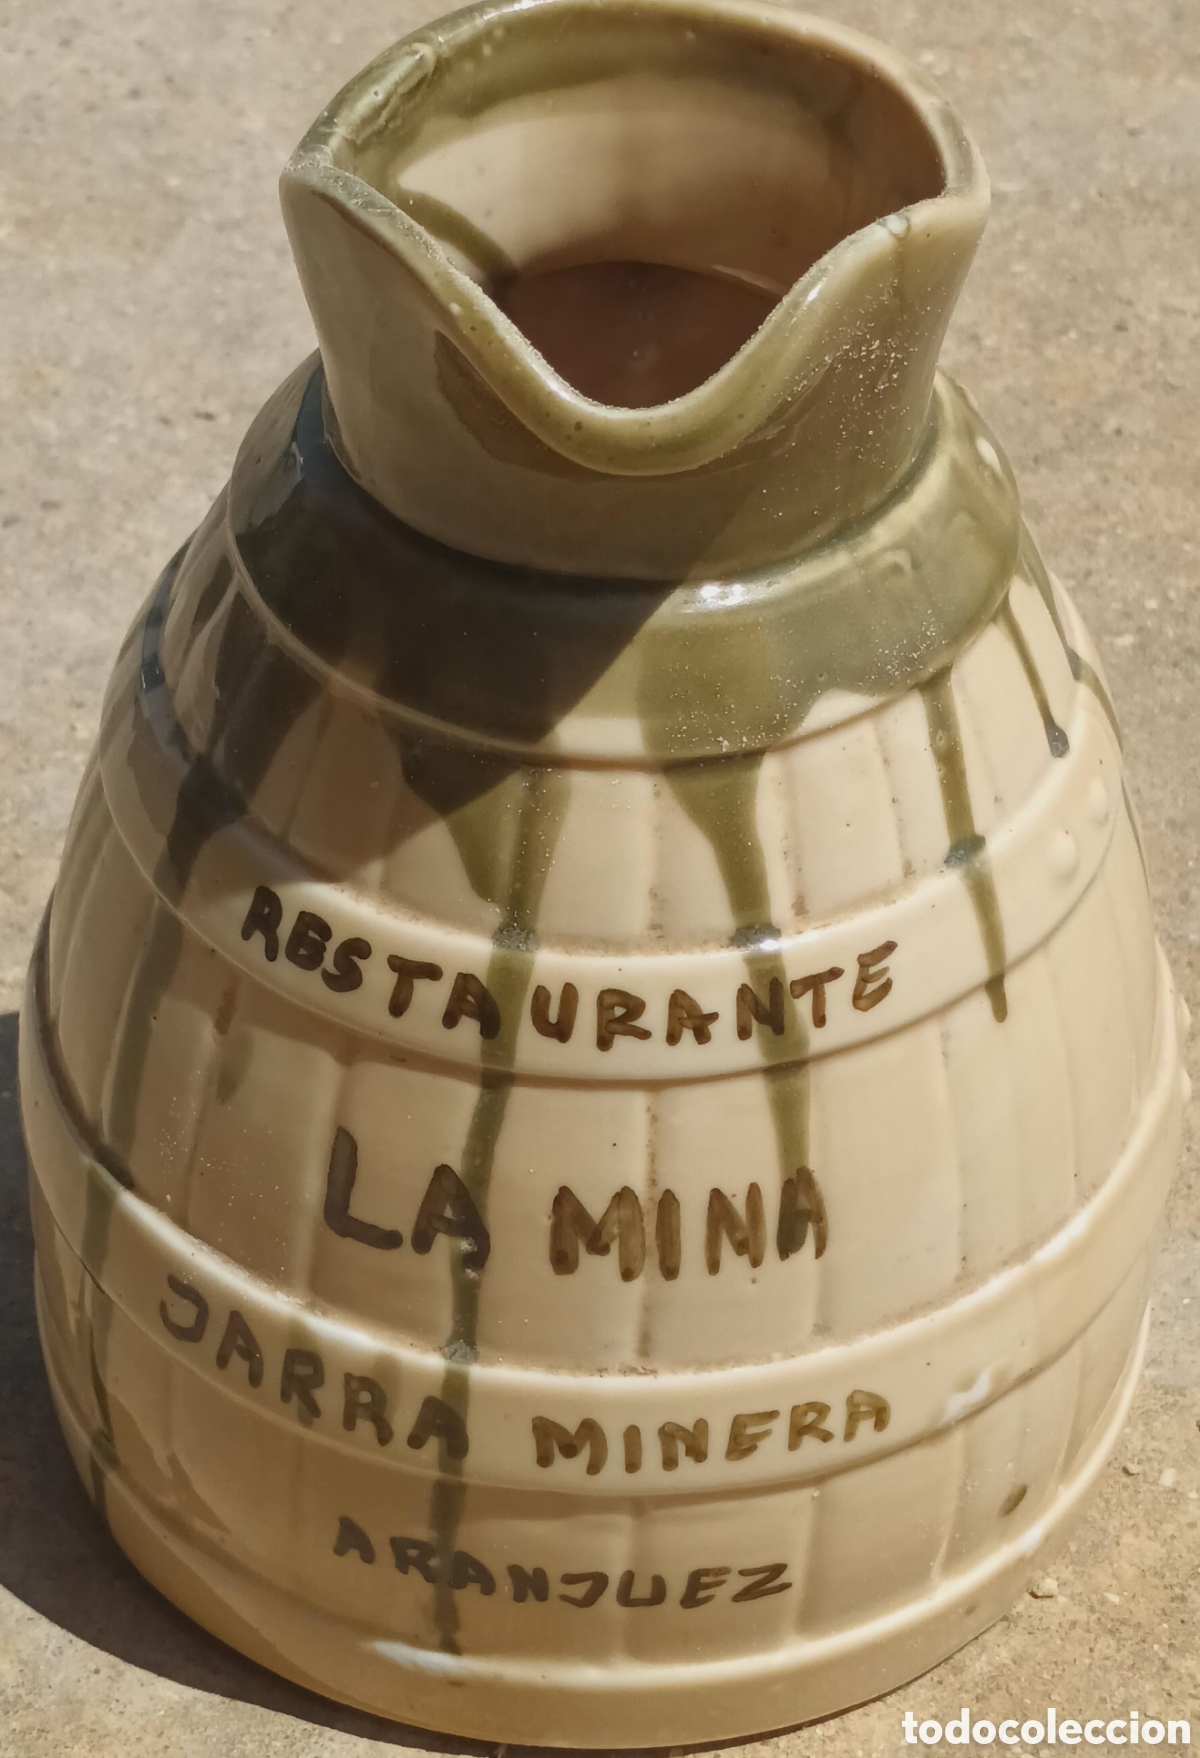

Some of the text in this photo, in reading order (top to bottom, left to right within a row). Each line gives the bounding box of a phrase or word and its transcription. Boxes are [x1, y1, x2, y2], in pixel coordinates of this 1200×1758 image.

[323, 1126, 829, 1281] LA MINA
[159, 1274, 891, 1476] JARRA MINERA
[333, 1516, 792, 1609] ARANJUEZ
